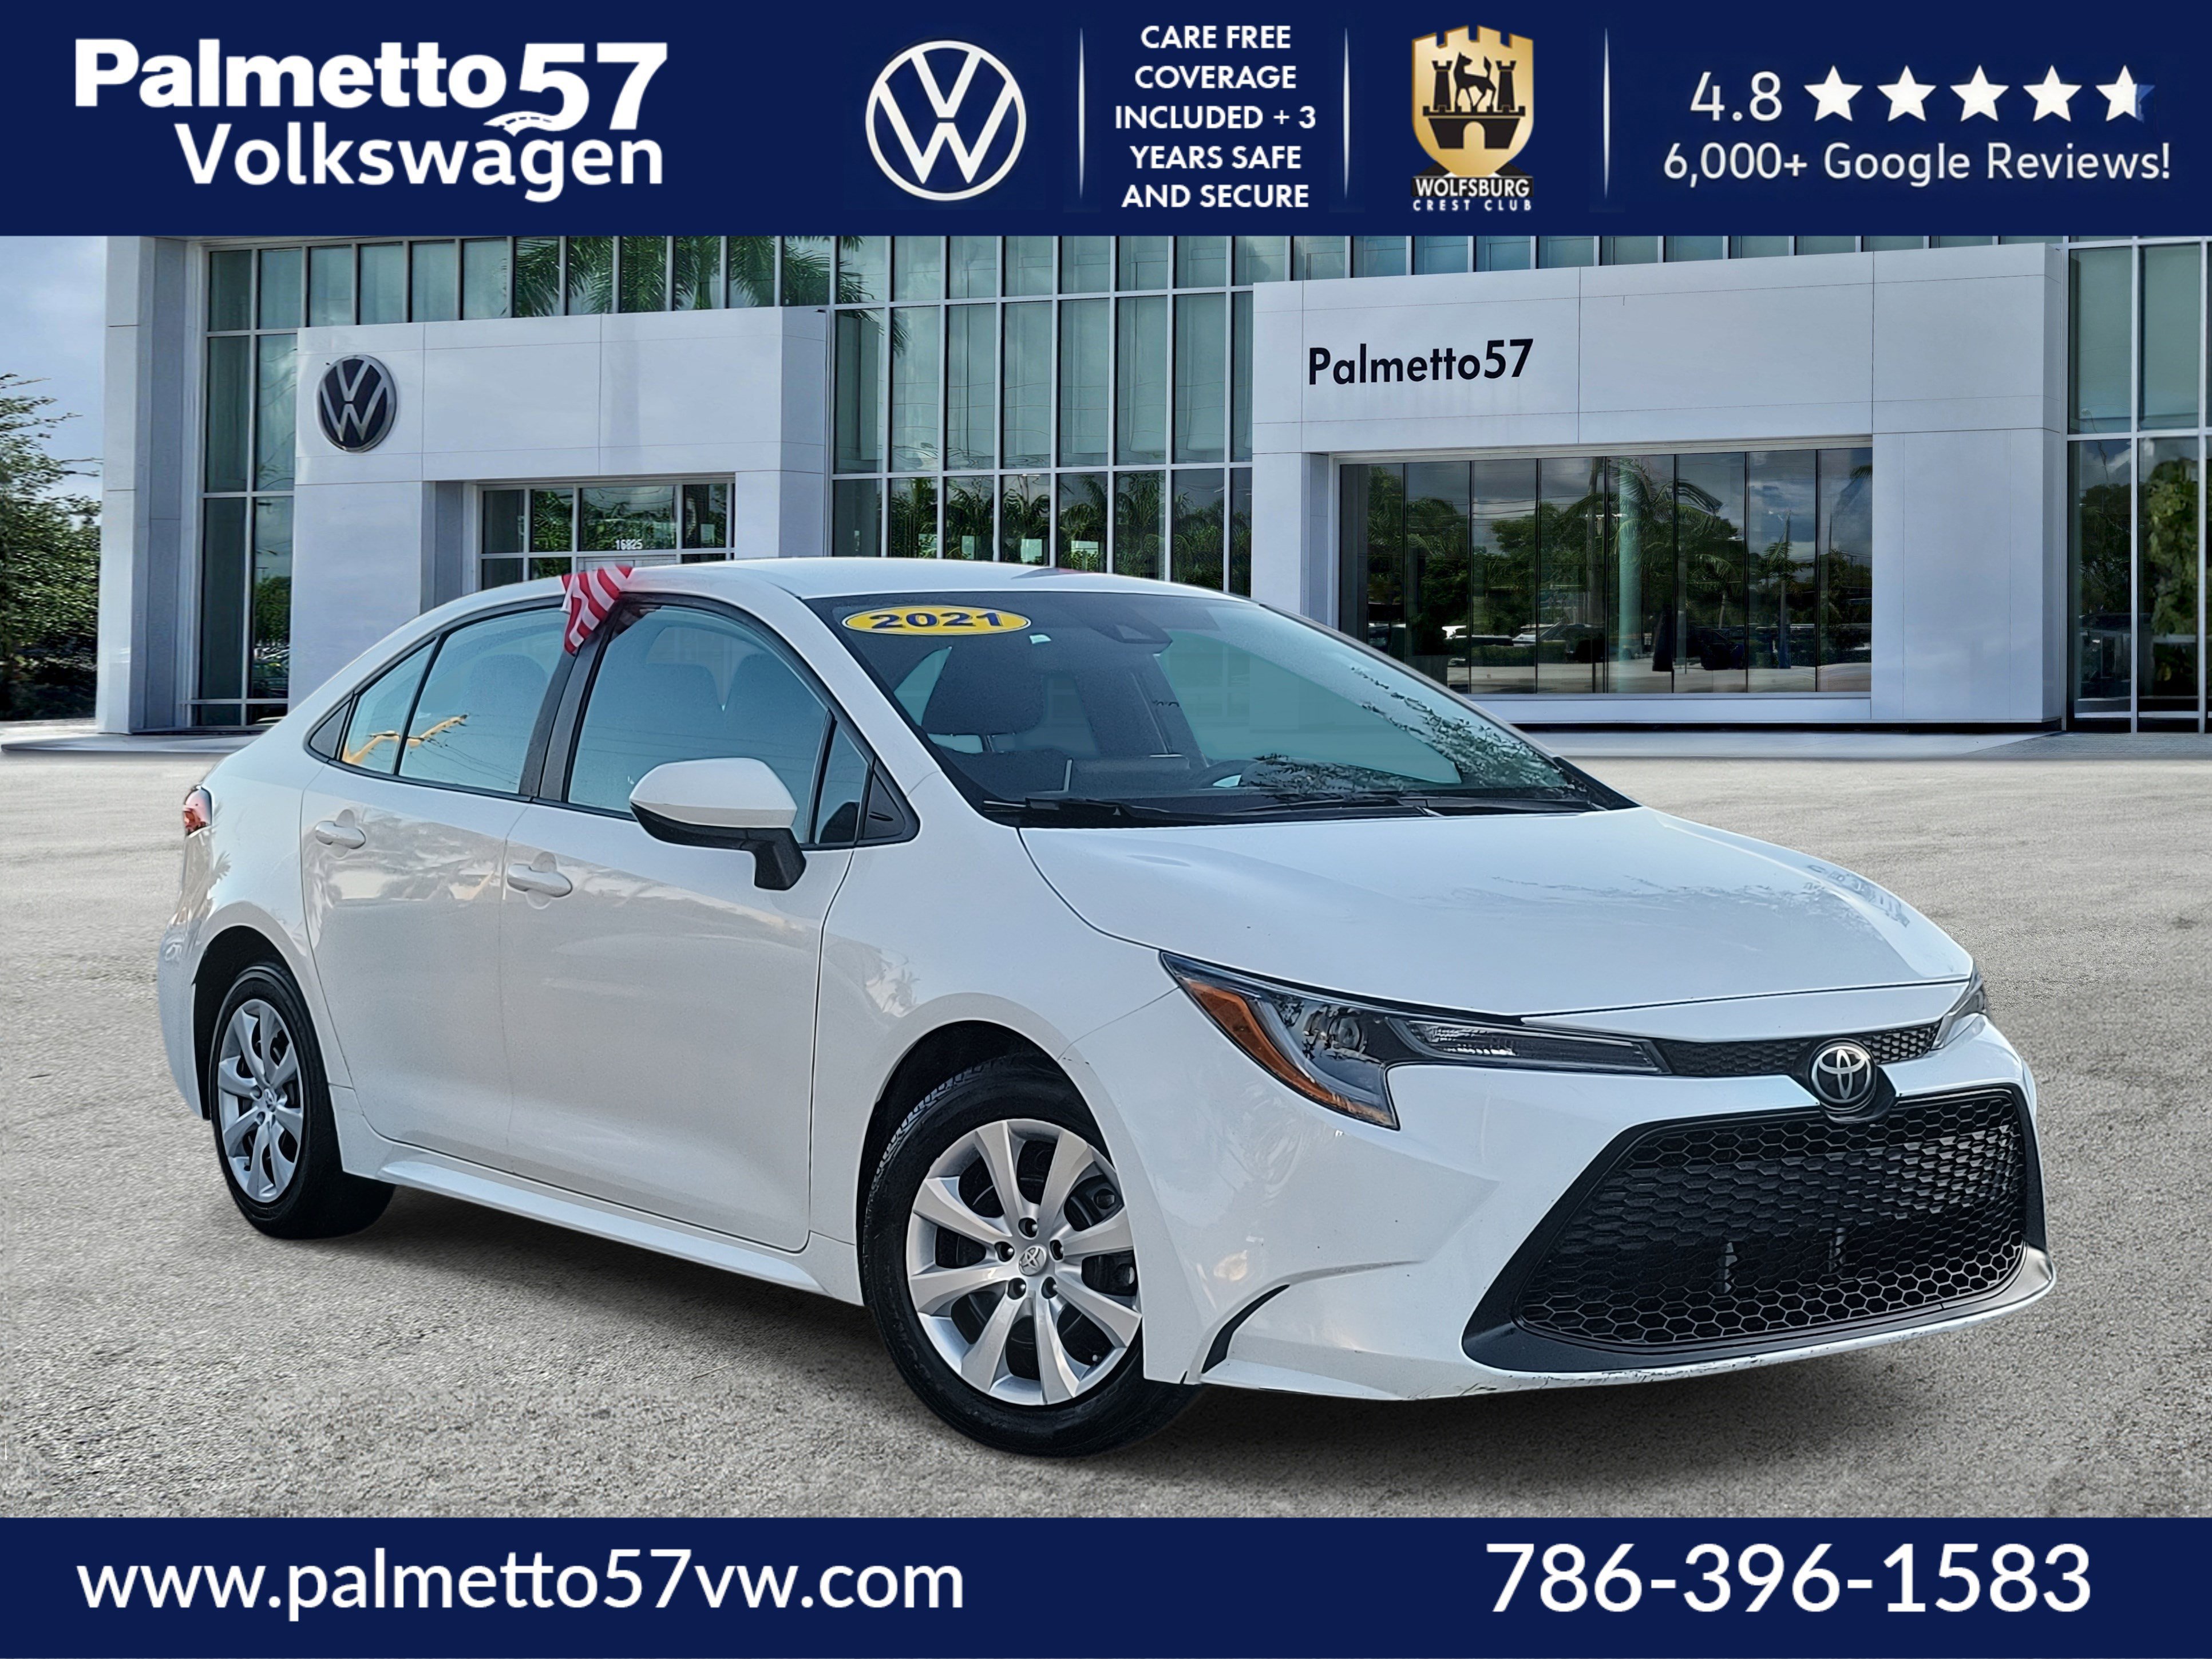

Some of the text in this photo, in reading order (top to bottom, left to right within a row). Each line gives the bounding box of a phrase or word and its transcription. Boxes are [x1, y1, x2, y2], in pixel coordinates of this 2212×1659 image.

[1308, 338, 1534, 385] Palmetto57
[615, 539, 643, 550] 16825
[869, 611, 1005, 629] 2021
